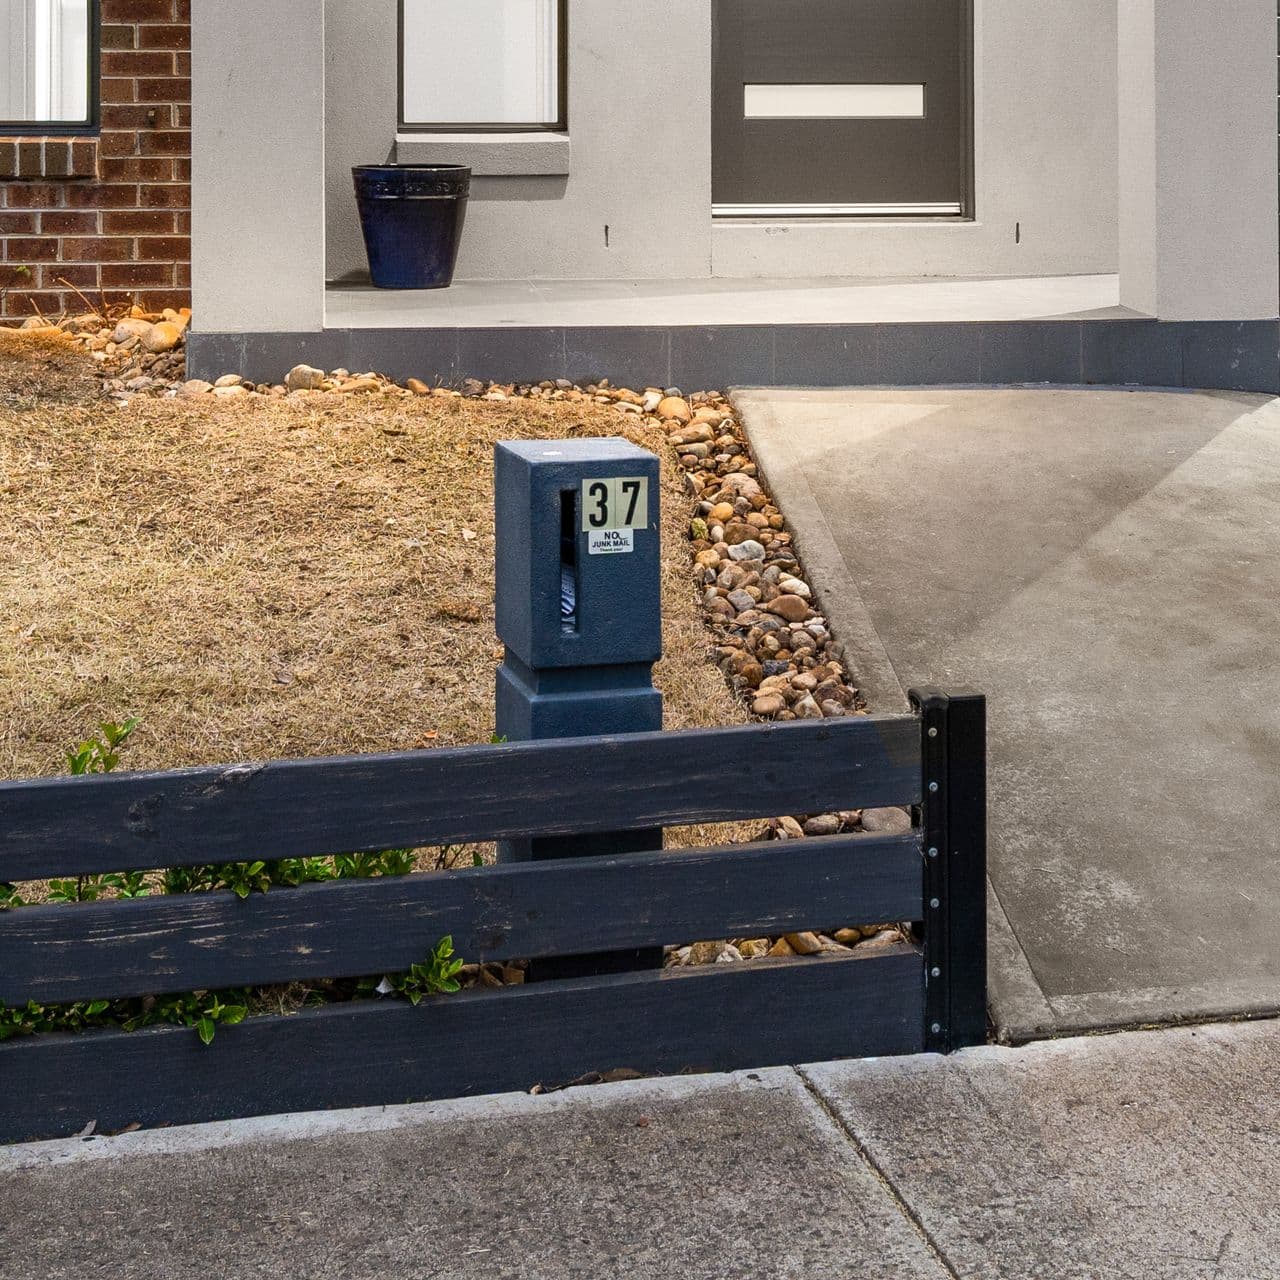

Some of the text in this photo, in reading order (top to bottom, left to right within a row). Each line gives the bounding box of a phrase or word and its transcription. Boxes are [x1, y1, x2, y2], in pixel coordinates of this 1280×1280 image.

[588, 481, 641, 527] 37
[604, 531, 620, 540] NO
[592, 540, 611, 548] JUNK
